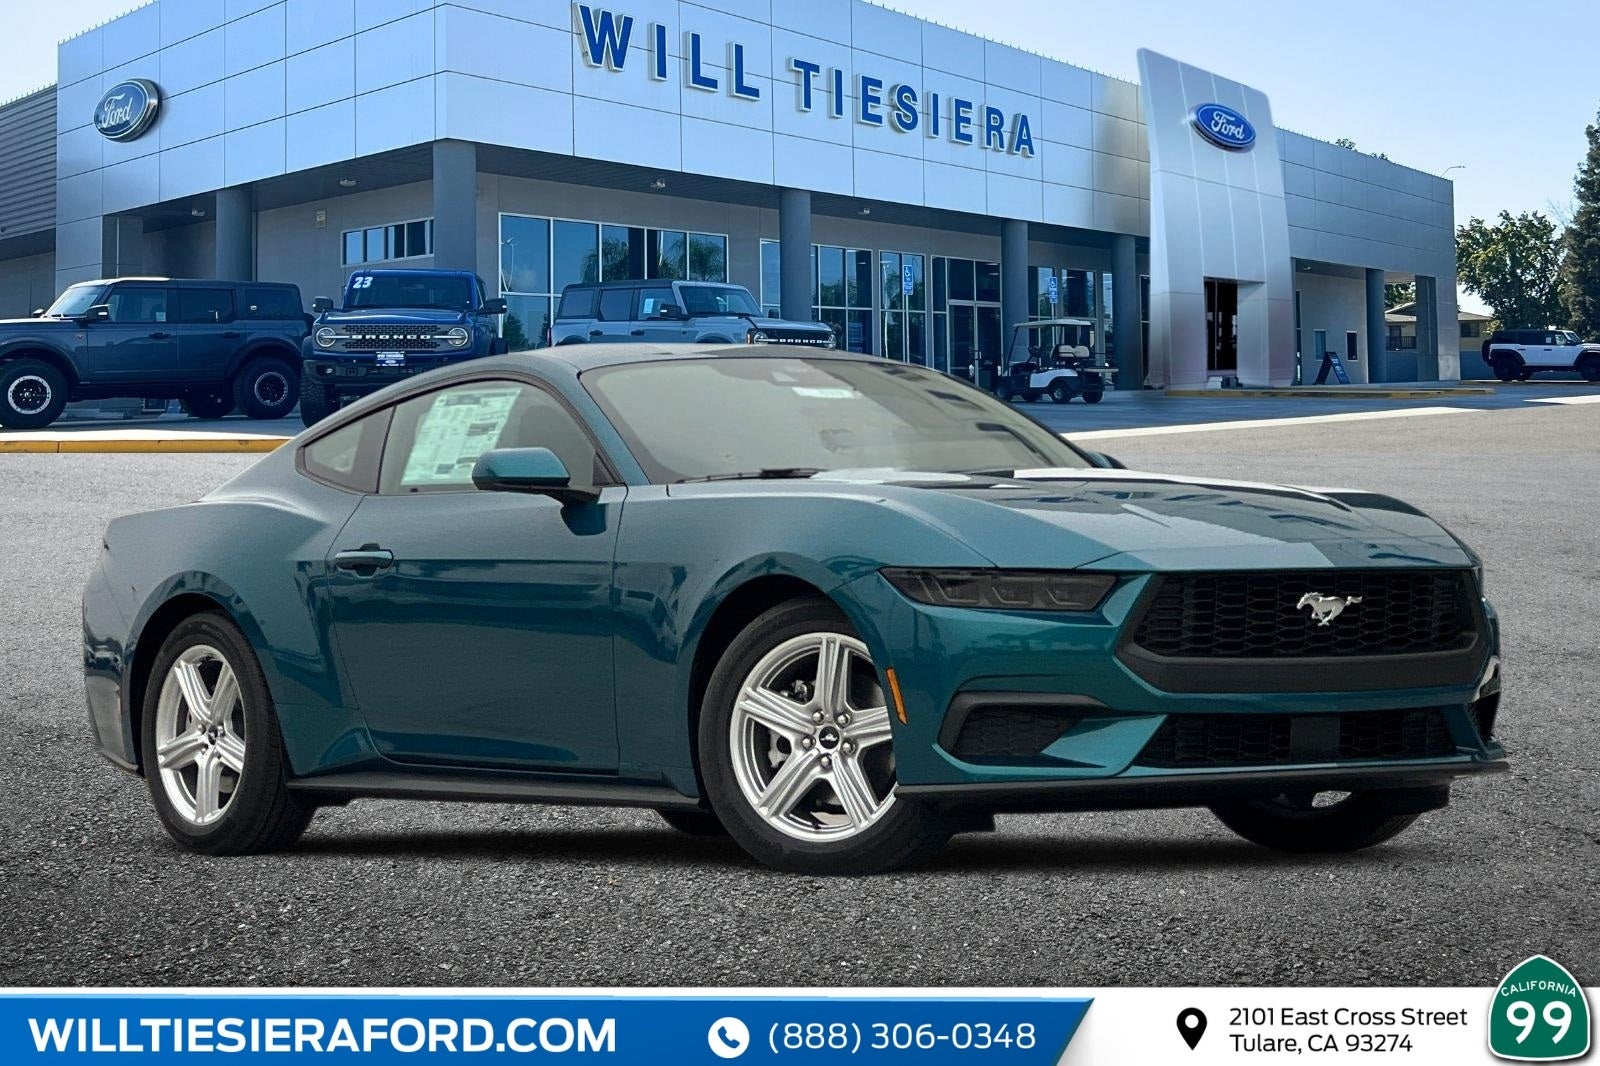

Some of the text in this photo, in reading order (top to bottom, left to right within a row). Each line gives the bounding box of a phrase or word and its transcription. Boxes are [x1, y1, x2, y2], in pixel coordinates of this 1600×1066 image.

[574, 2, 1036, 158] WILL TIESIERA
[101, 93, 133, 129] Ford
[1211, 110, 1245, 140] Ford
[353, 276, 373, 289] 23
